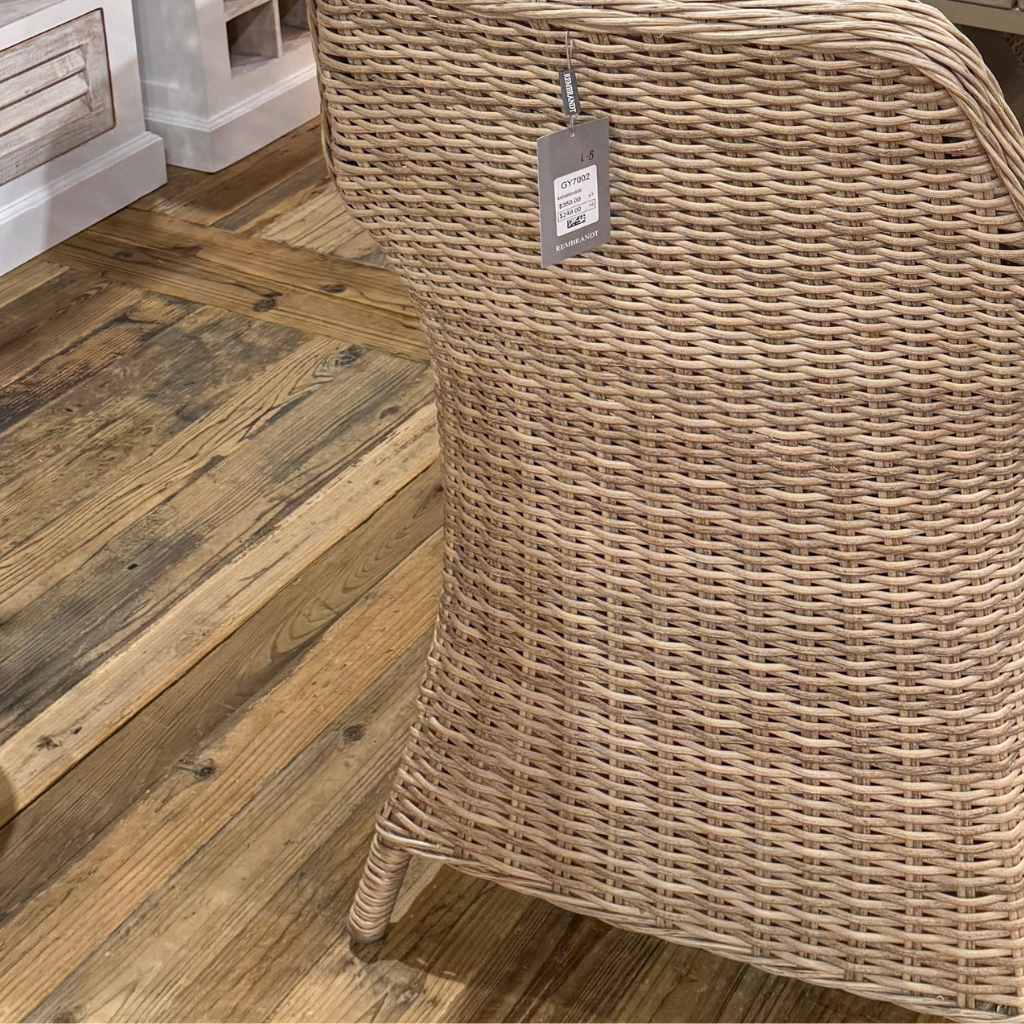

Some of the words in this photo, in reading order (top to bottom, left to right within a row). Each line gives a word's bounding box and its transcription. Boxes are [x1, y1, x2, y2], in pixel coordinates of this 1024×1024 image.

[564, 73, 577, 113] REMBRANDT
[560, 172, 591, 190] GY7002
[555, 230, 599, 252] REMBRANDT
